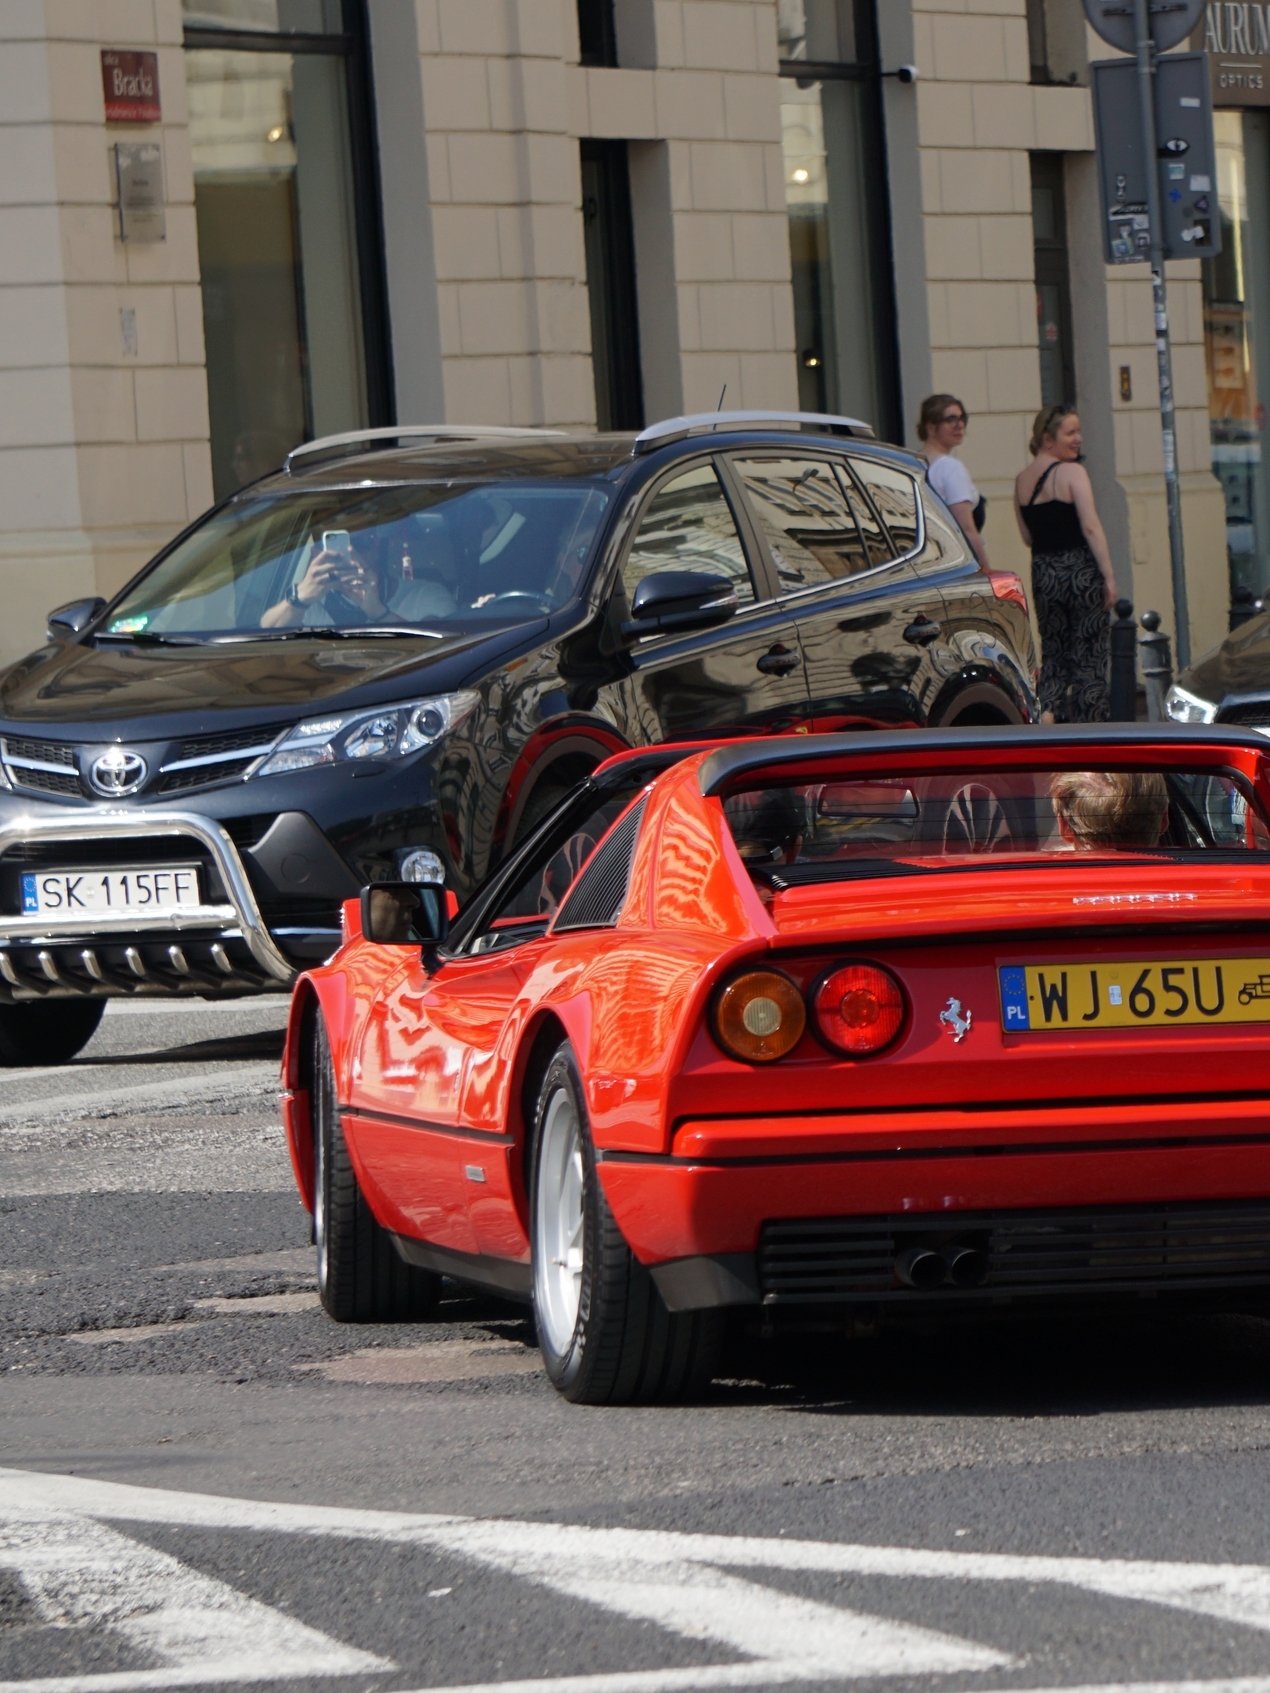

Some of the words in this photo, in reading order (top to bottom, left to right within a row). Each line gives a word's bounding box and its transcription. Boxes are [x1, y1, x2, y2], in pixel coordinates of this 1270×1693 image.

[113, 67, 154, 97] Bracka
[1219, 73, 1264, 89] OPTICS
[25, 896, 38, 907] PL
[42, 876, 87, 908] SK
[101, 872, 191, 906] 115FF
[1037, 970, 1100, 1023] WJ
[1128, 966, 1225, 1018] 65U
[1006, 1006, 1026, 1020] PL
